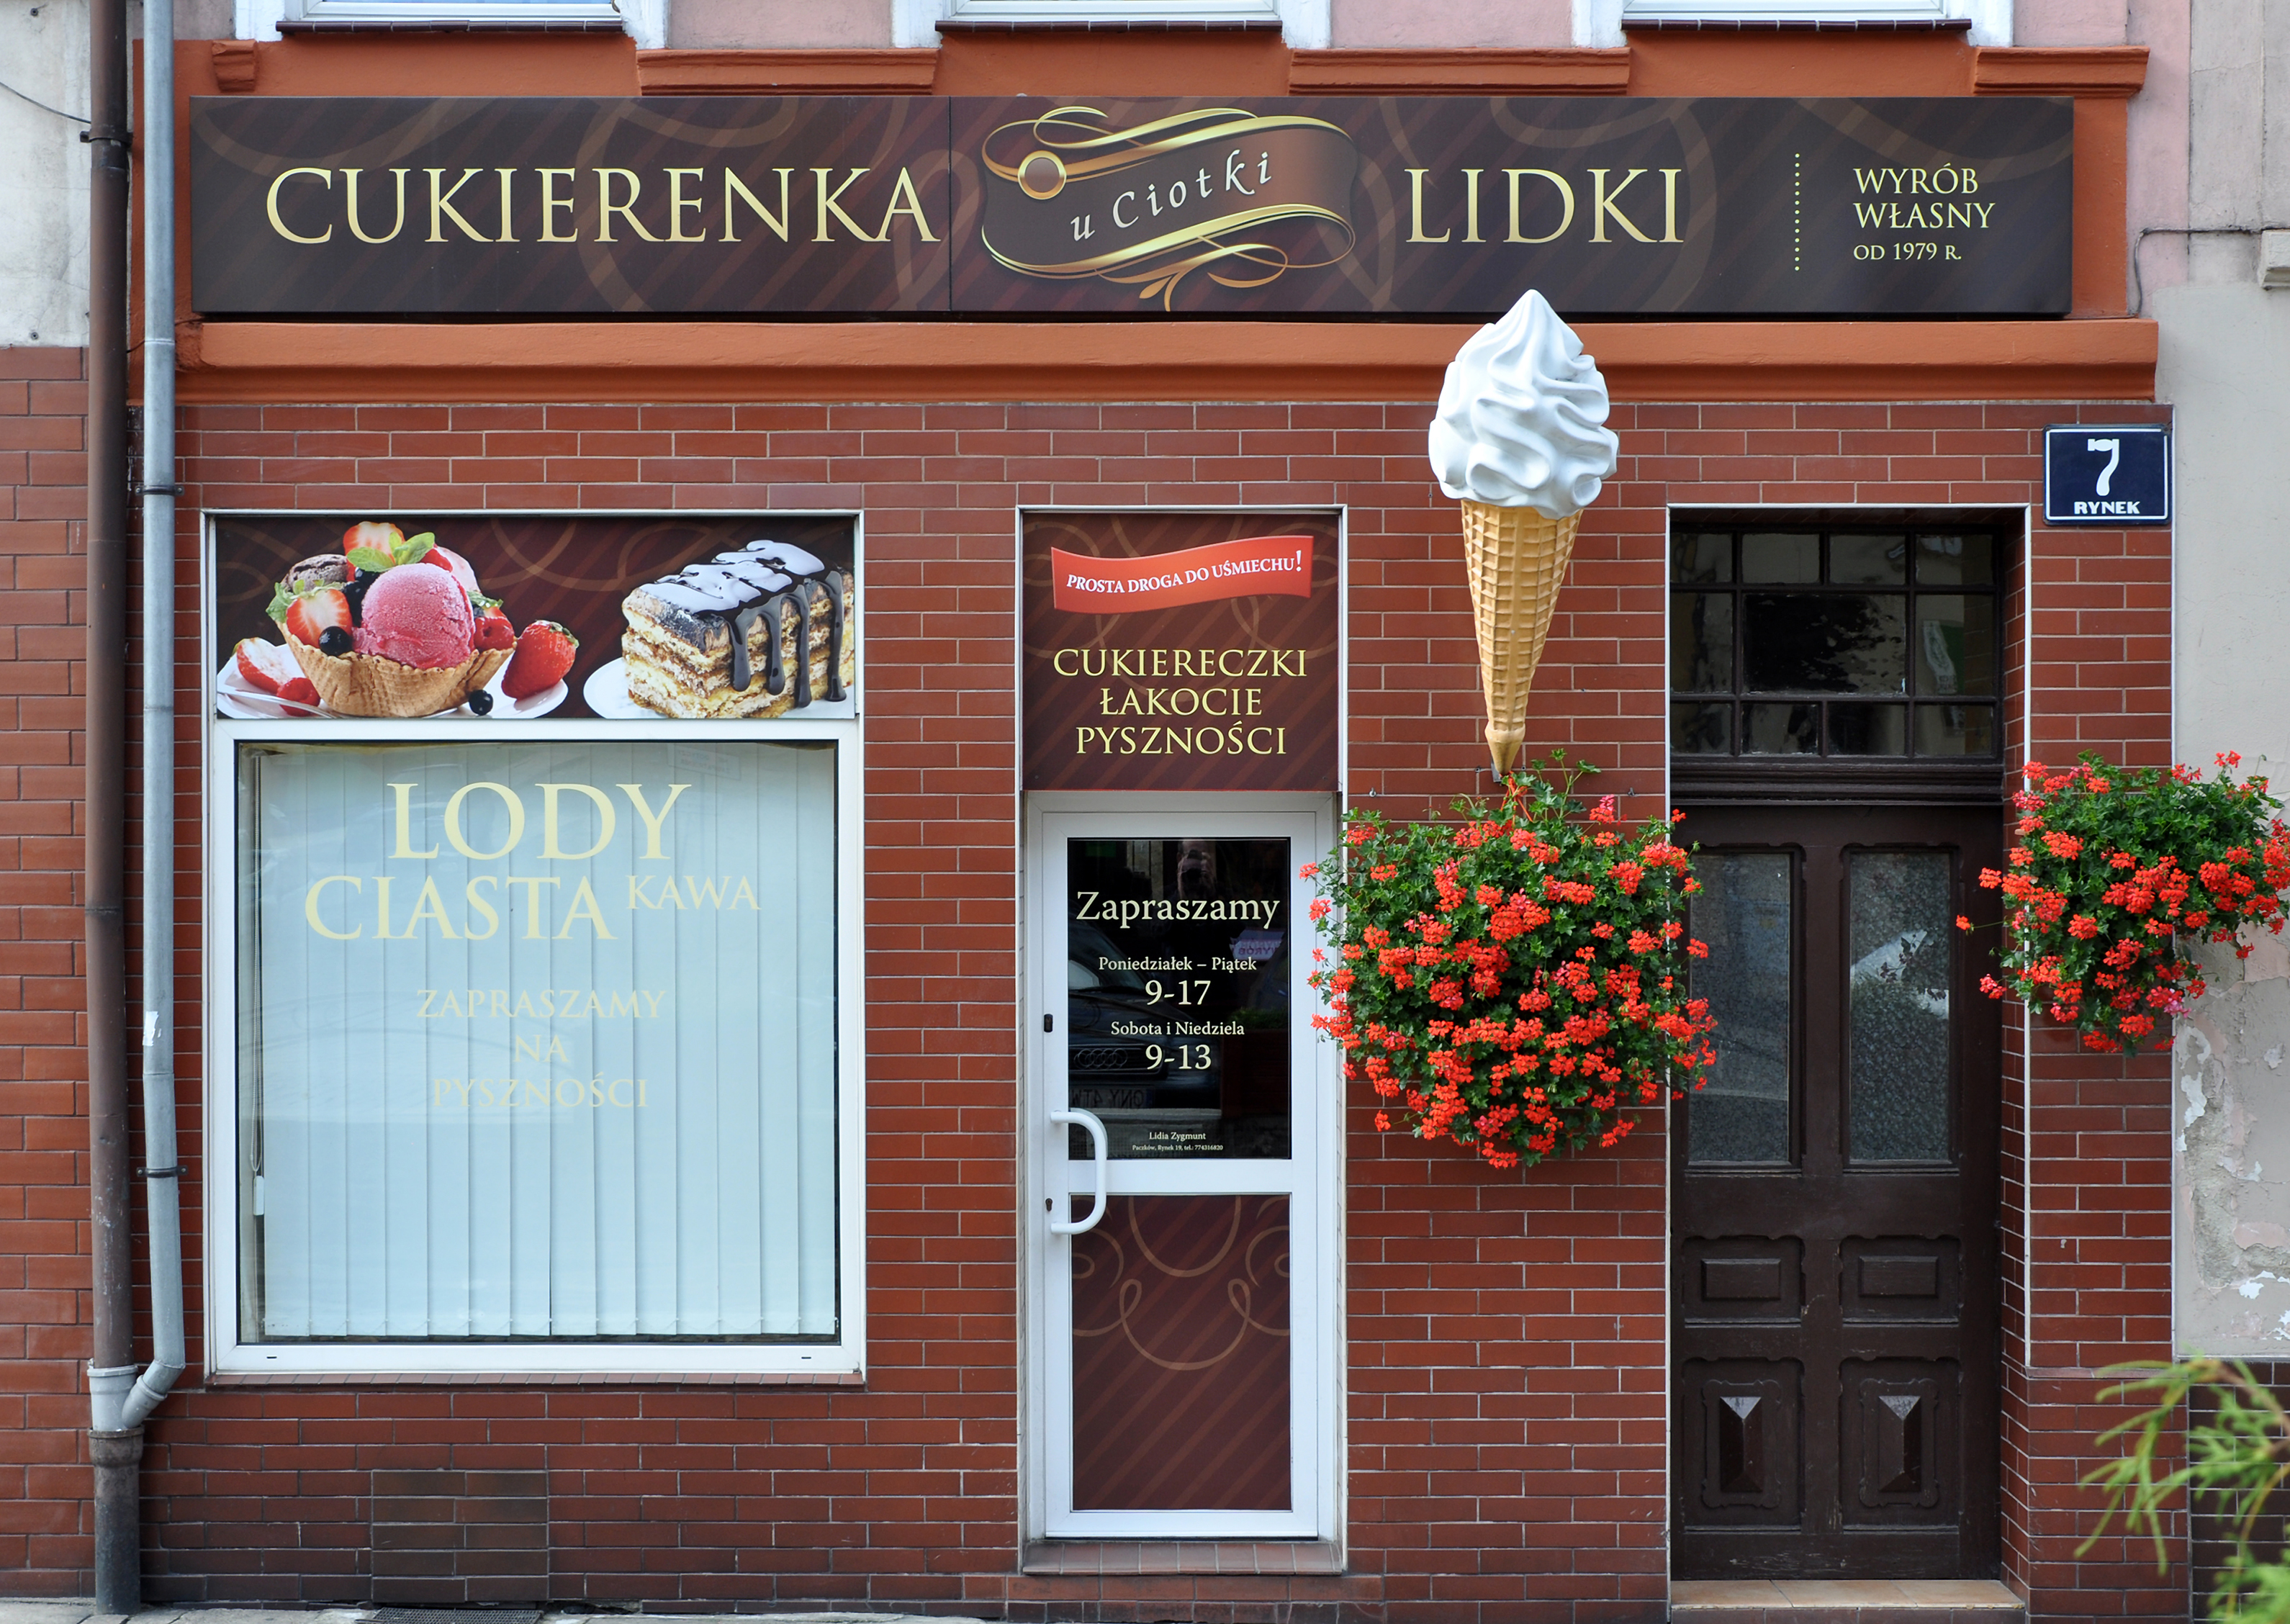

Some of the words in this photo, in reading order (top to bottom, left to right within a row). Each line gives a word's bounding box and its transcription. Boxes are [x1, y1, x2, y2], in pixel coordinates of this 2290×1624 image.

[1853, 163, 1979, 194] WYRÓB
[266, 167, 941, 244] CUKIERENKA
[1070, 214, 1096, 242] u
[1112, 148, 1273, 229] Ciotki
[1404, 168, 1685, 243] LIDKI
[1852, 202, 1996, 230] WŁASNY
[1853, 244, 1885, 261] OD
[1893, 243, 1938, 261] 1979
[1945, 244, 1962, 261] R.
[2088, 438, 2120, 497] 7
[2074, 501, 2141, 515] RYNEK
[1066, 574, 1125, 593] PROSTA
[1127, 573, 1184, 593] DROGA
[1186, 567, 1209, 584] DO
[1211, 549, 1302, 577] UŚMIECHU!
[1053, 649, 1307, 677] CUKIERECZKI
[1099, 687, 1263, 716] ŁAKOCIE
[1076, 720, 1286, 754] PYSZNOŚCI
[387, 782, 693, 860] LODY
[305, 875, 619, 940] CIASTA
[625, 875, 762, 910] KAWA
[1076, 891, 1281, 929] Zapraszamy
[1099, 956, 1193, 970] Poniedziałek
[1212, 956, 1258, 973] Piątek
[415, 989, 667, 1019] ZAPRASZAMY
[1145, 980, 1212, 1006] 9-17
[1111, 1021, 1163, 1035] Sobota
[1166, 1021, 1171, 1035] i
[1175, 1021, 1245, 1035] Niedziela
[513, 1034, 570, 1063] NA
[1145, 1044, 1212, 1070] 9-13
[433, 1071, 649, 1108] PYSZNOŚCI
[1149, 1131, 1169, 1140] Lidia
[1171, 1132, 1207, 1142] Zygmunt
